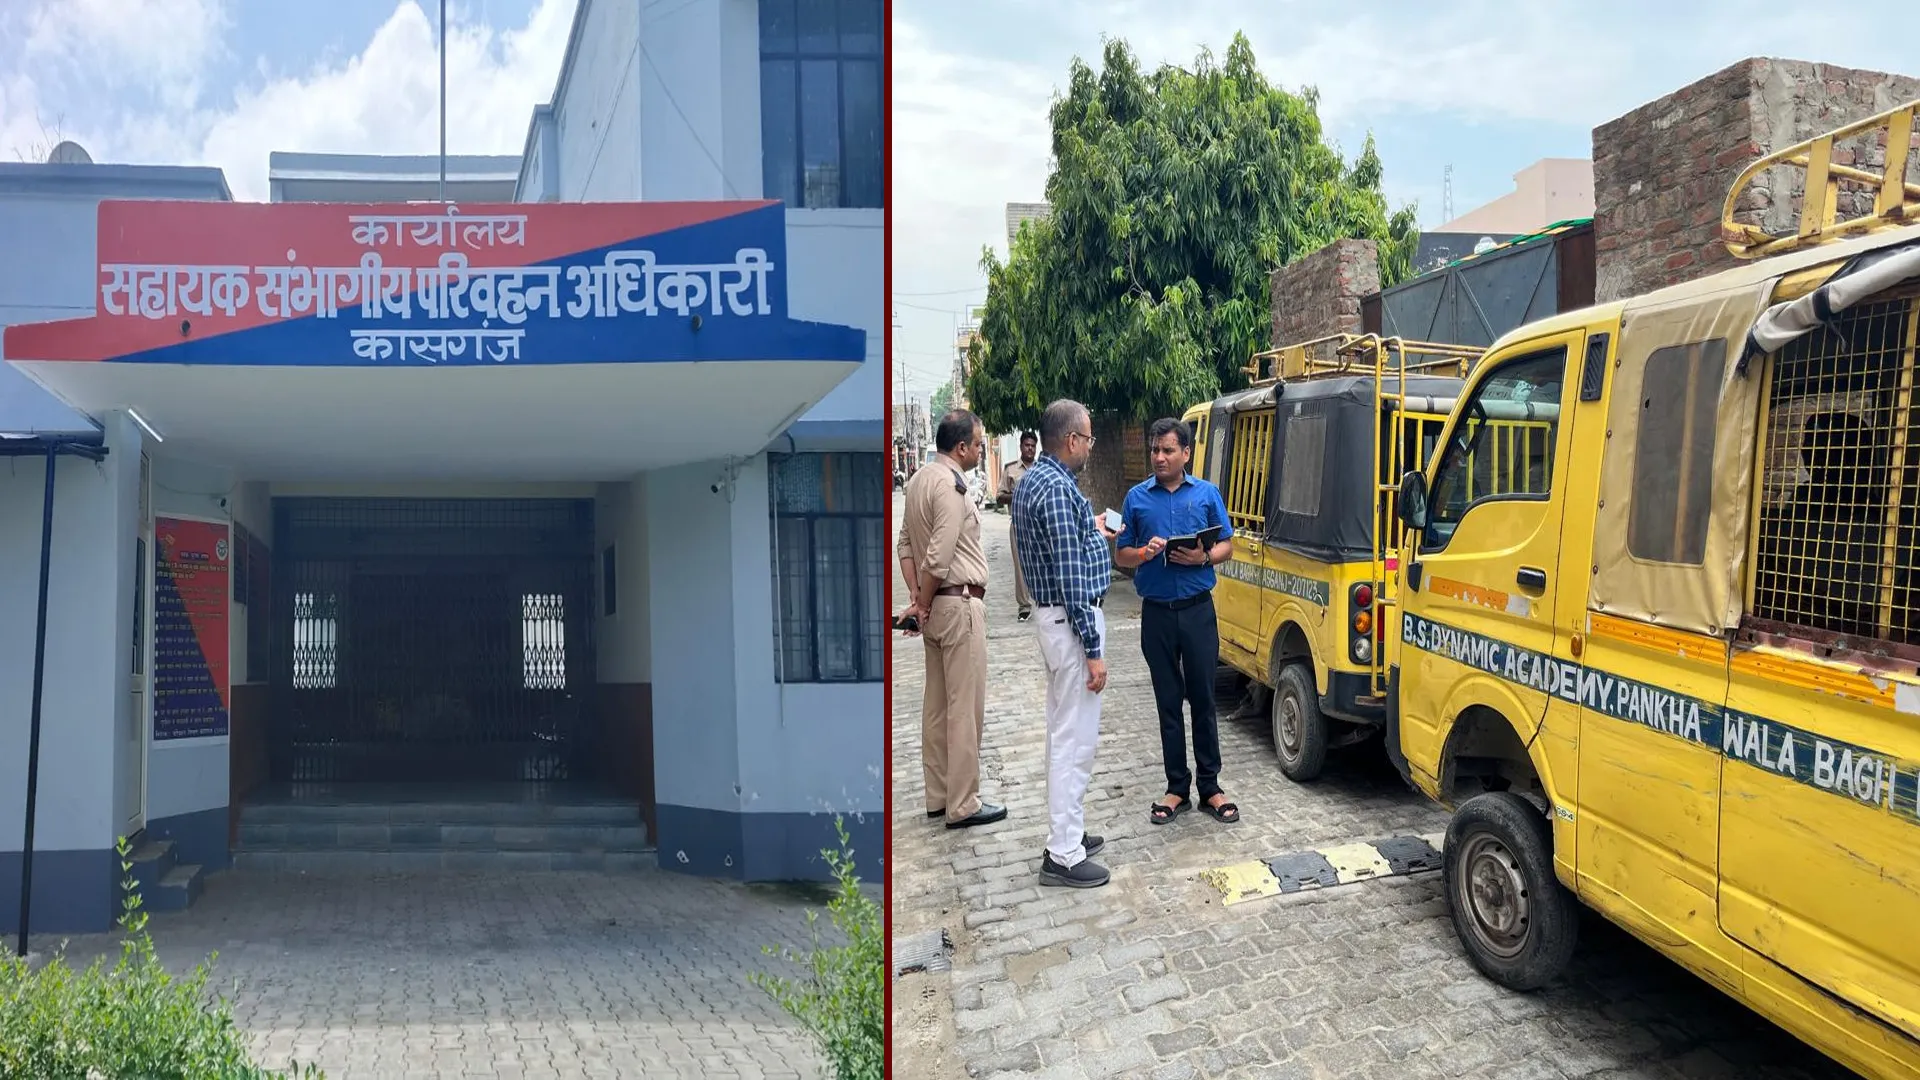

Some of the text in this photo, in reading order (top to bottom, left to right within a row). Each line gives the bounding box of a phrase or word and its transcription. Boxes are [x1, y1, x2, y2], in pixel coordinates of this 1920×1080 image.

[349, 205, 528, 250] कार्यालय
[100, 247, 774, 325] सहायक संभागीय परिवहन अधिकारी
[350, 319, 526, 363] कासगंज
[1723, 712, 1797, 777] WALA
[1813, 740, 1897, 810] BAGH
